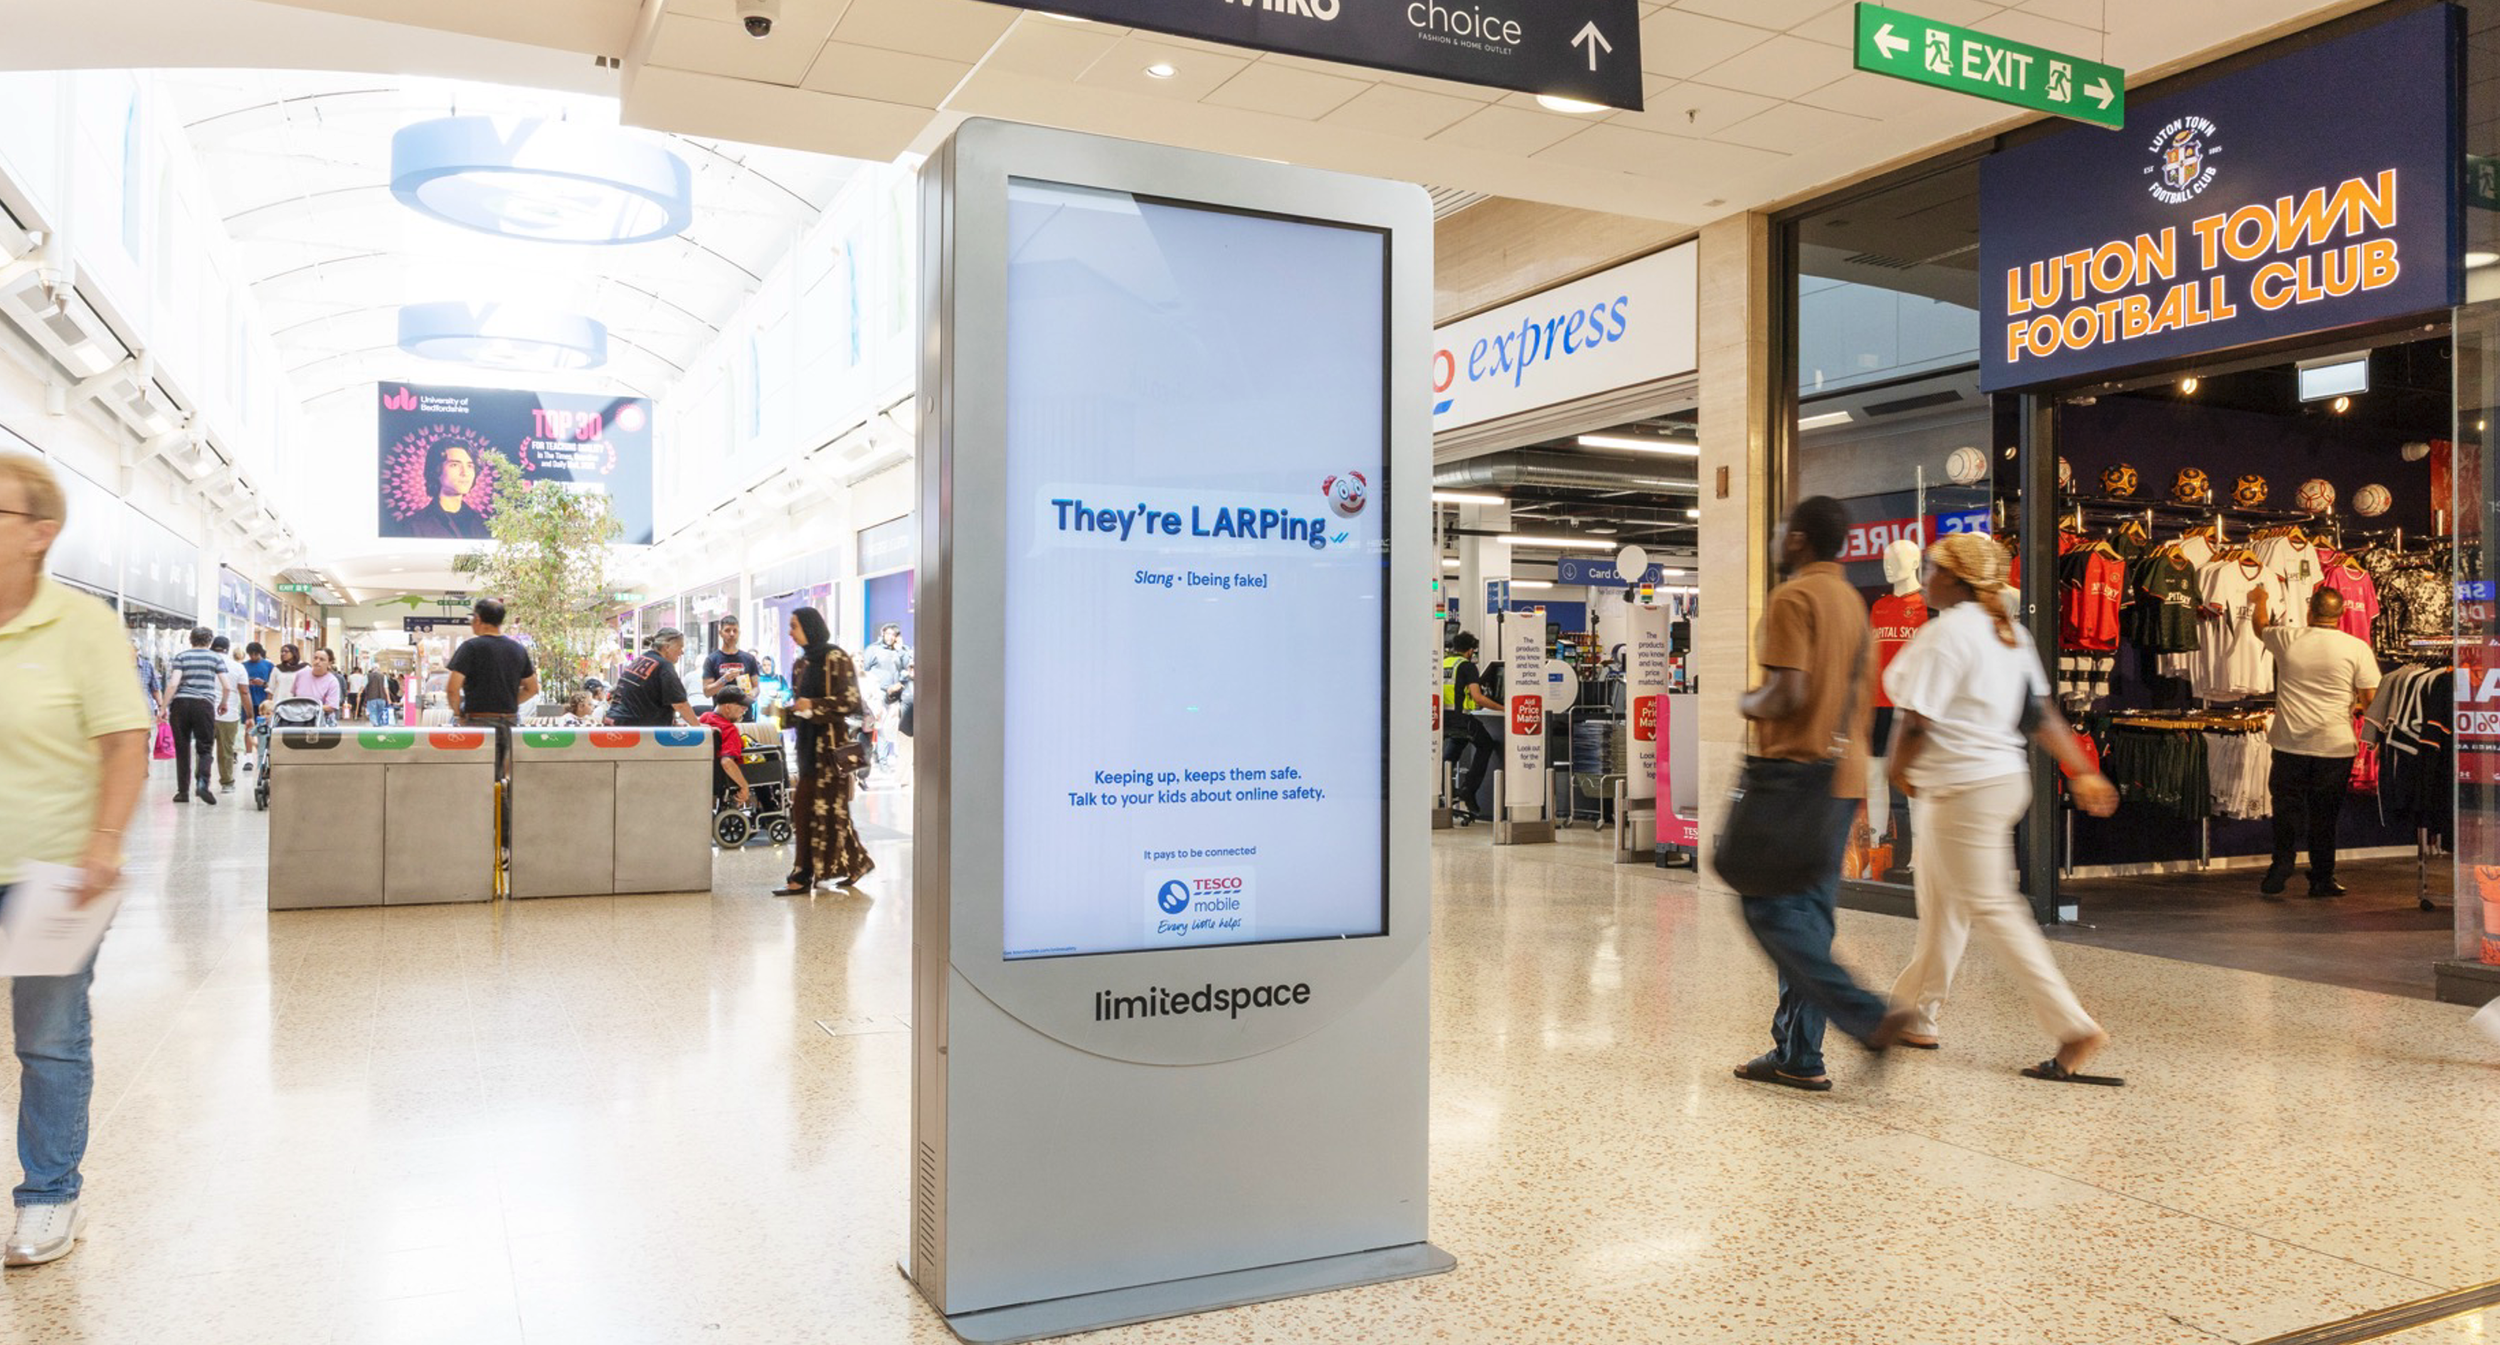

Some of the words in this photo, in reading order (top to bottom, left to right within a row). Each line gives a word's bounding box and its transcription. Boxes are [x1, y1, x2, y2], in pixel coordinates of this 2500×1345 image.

[1407, 0, 1522, 45] choice
[1418, 32, 1451, 44] FASHION
[1460, 40, 1482, 50] HOME
[1484, 45, 1512, 55] OUTLET
[1961, 39, 2034, 91] EXIT
[2148, 118, 2183, 153] LUTON
[2184, 115, 2217, 138] TOWN
[2143, 165, 2155, 175] EST
[2148, 181, 2195, 205] FOOTBALL
[2192, 166, 2217, 194] CLUB
[2007, 226, 2177, 316] LUTON
[2193, 168, 2398, 272] TOWN
[2007, 275, 2237, 363] FOOTBALL
[2250, 237, 2401, 311] CLUB
[1467, 295, 1629, 388] express
[420, 395, 458, 406] University
[459, 397, 469, 406] of
[420, 403, 470, 414] Bedfordshire
[531, 408, 573, 440] TOP
[575, 411, 603, 441] 30
[531, 441, 545, 451] FOR
[1191, 505, 1327, 550] LARPing
[1134, 570, 1174, 589] Slang
[1187, 570, 1231, 590] [being
[1234, 573, 1268, 588] fake]
[1589, 568, 1611, 579] Card
[1646, 631, 1657, 639] The
[1899, 626, 1919, 639] SKY
[1638, 651, 1649, 659] you
[1516, 714, 1540, 724] Match
[1519, 705, 1539, 714] Price
[1643, 761, 1652, 769] for
[1094, 770, 1154, 787] Keeping
[1157, 771, 1180, 786] up,
[1184, 769, 1226, 785] keeps
[1229, 767, 1267, 781] them
[1270, 766, 1302, 780] safe.
[1068, 792, 1097, 806] Talk
[1101, 792, 1117, 806] to
[1121, 793, 1154, 808] your
[1158, 790, 1187, 803] kids
[1190, 789, 1232, 802] about
[1235, 787, 1279, 801] online
[1281, 786, 1326, 802] safety.
[1144, 850, 1151, 860] It
[1153, 852, 1176, 861] pays
[1178, 850, 1188, 859] to
[1190, 849, 1203, 858] be
[1204, 846, 1257, 857] connected
[1193, 876, 1242, 891] TESCO
[1194, 897, 1240, 912] mobile
[1157, 919, 1188, 937] Every
[1191, 918, 1216, 931] little
[1218, 917, 1242, 931] helps
[1096, 982, 1311, 1021] limitedspace
